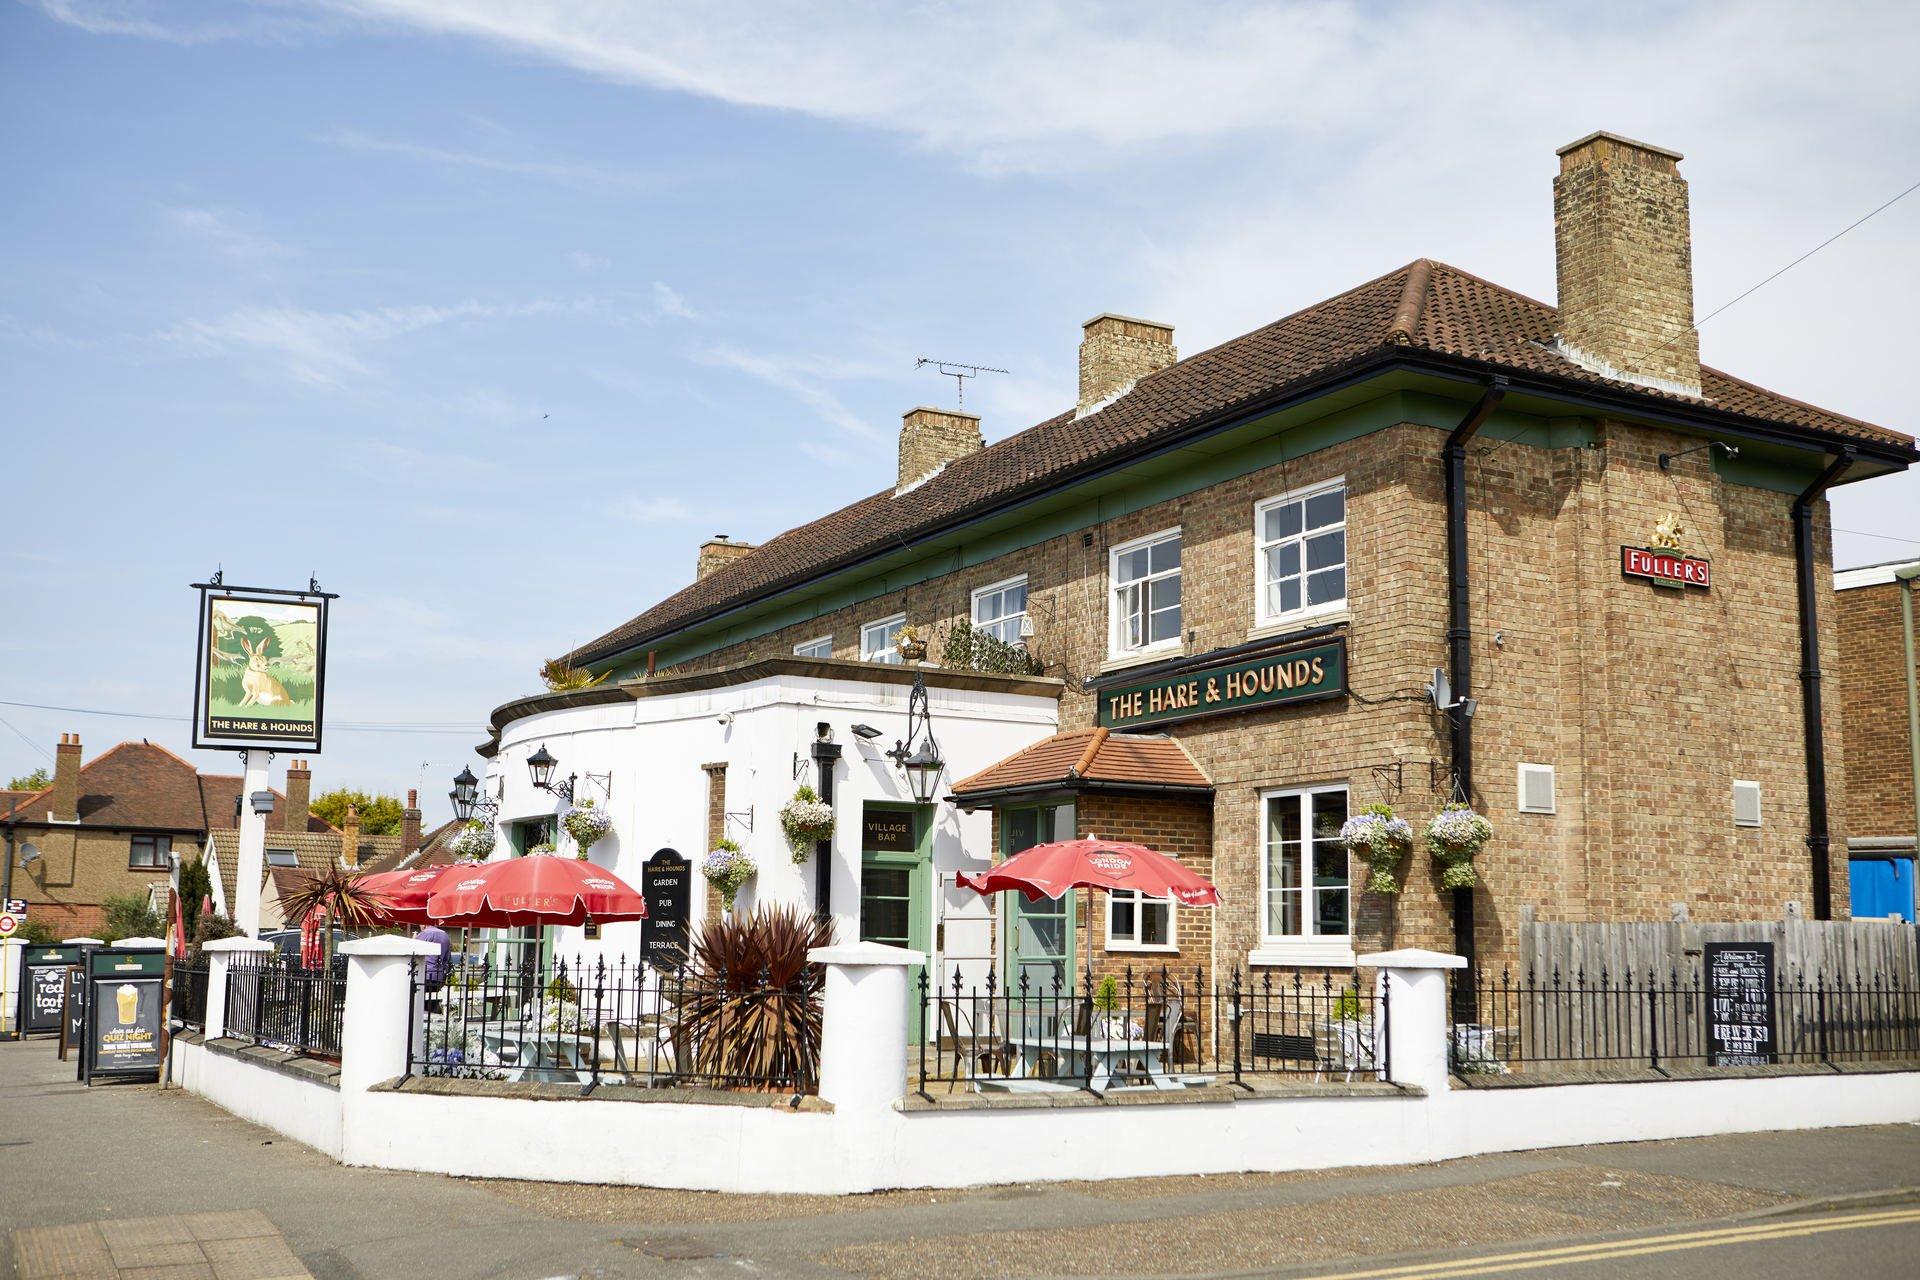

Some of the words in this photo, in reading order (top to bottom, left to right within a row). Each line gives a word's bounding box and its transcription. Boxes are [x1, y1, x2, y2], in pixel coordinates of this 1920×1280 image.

[1630, 552, 1706, 582] FULLER'S
[1110, 692, 1143, 720] THE
[1149, 681, 1199, 714] HARE
[1205, 677, 1221, 704] &
[1226, 656, 1325, 700] HOUNDS
[211, 720, 230, 729] THE
[232, 721, 258, 730] HARE
[260, 722, 268, 731] &
[270, 723, 313, 733] HOUNDS
[868, 823, 907, 833] VILLAGE
[877, 833, 896, 842] BAR
[1088, 857, 1132, 866] LONDON
[582, 878, 616, 886] LONDON
[653, 879, 678, 887] GARDEN
[658, 899, 673, 907] PUB
[655, 920, 676, 928] DINING
[649, 941, 679, 949] TERRACE
[39, 979, 65, 994] red
[36, 993, 65, 1008] toot
[103, 1033, 124, 1043] QUIZ
[125, 1032, 153, 1041] NIGHT
